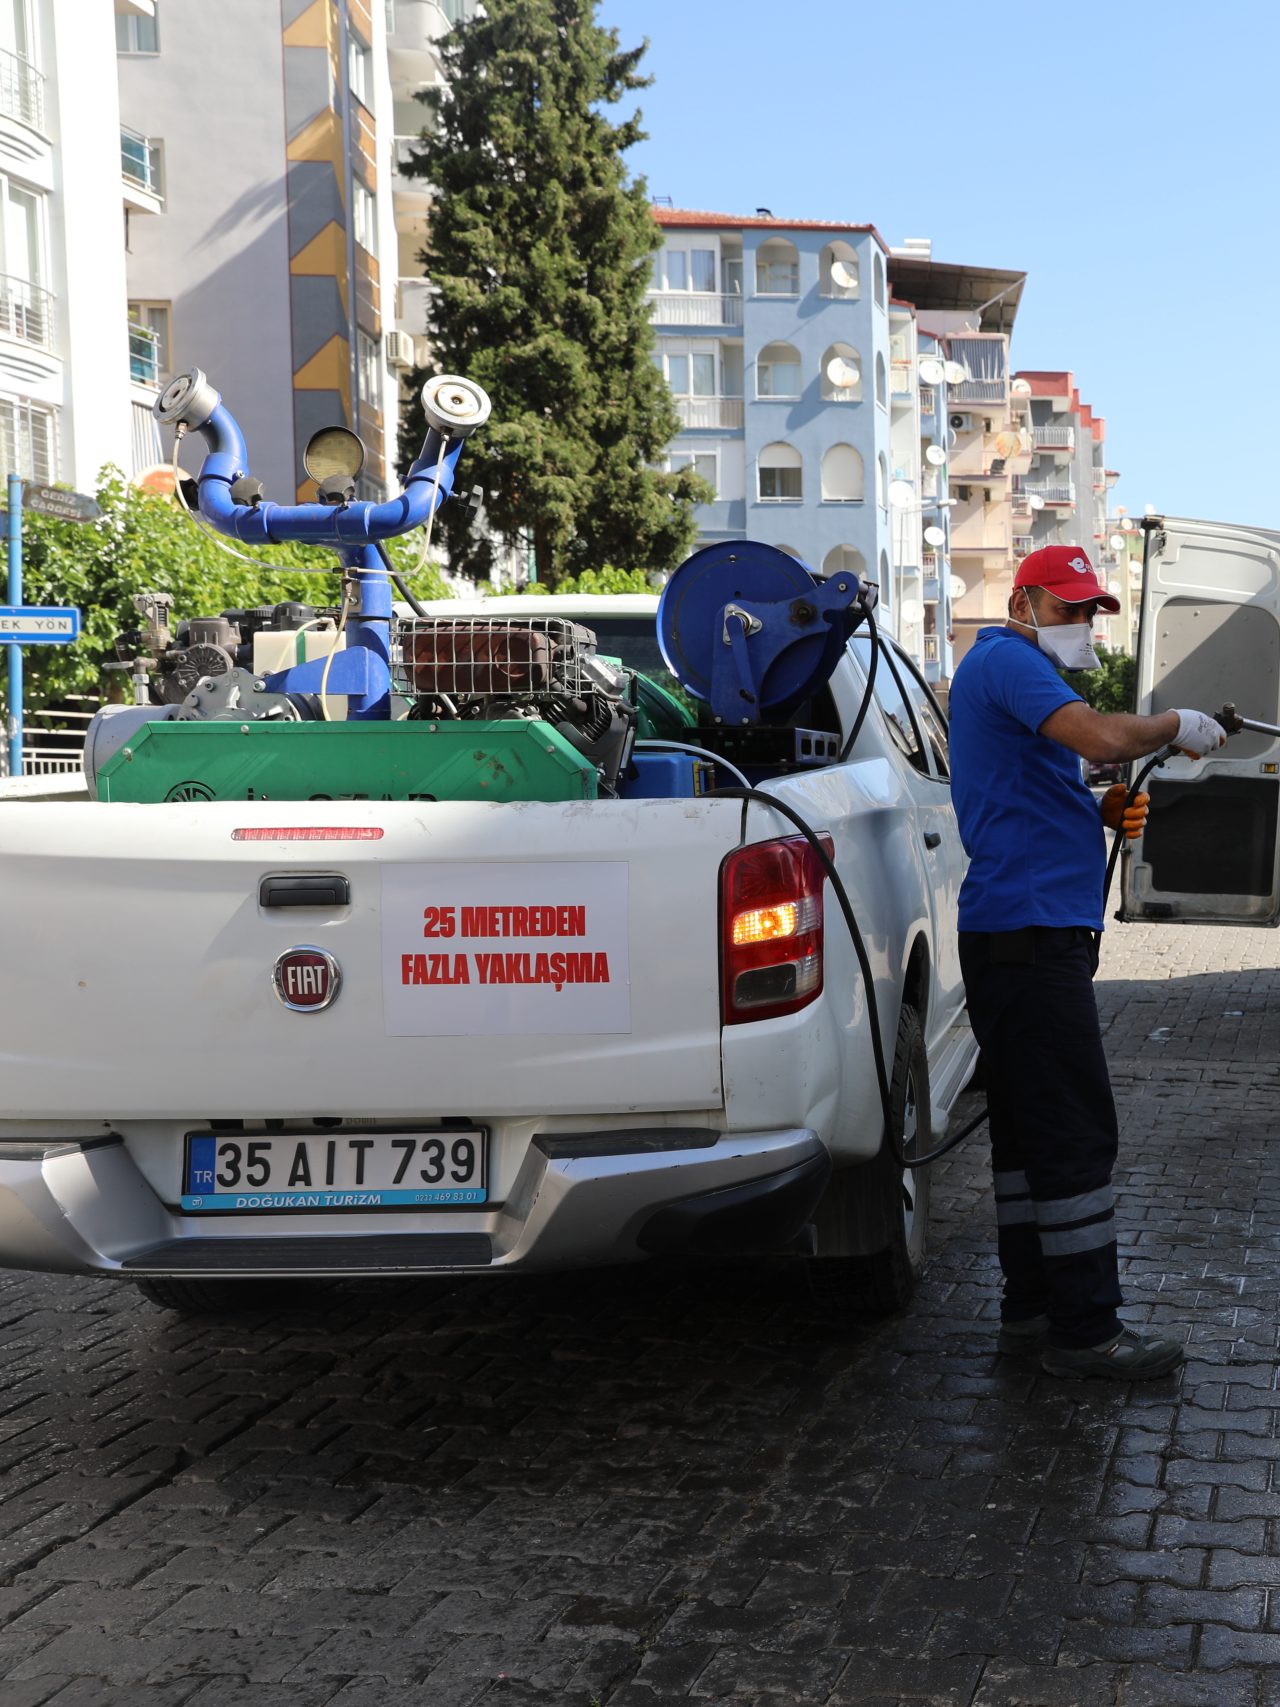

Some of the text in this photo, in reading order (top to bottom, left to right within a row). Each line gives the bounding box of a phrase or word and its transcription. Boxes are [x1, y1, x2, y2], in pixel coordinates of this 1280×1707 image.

[34, 617, 67, 630] YÖN
[423, 905, 586, 938] 25 METREDEN
[287, 965, 326, 995] FIAT
[401, 952, 610, 993] FAZLA YAKLAŞMA
[194, 1170, 213, 1184] TR
[216, 1138, 476, 1188] 35 AIT 739
[235, 1194, 320, 1209] DOĞUKAN
[434, 1192, 451, 1201] 469
[453, 1192, 464, 1201] 83
